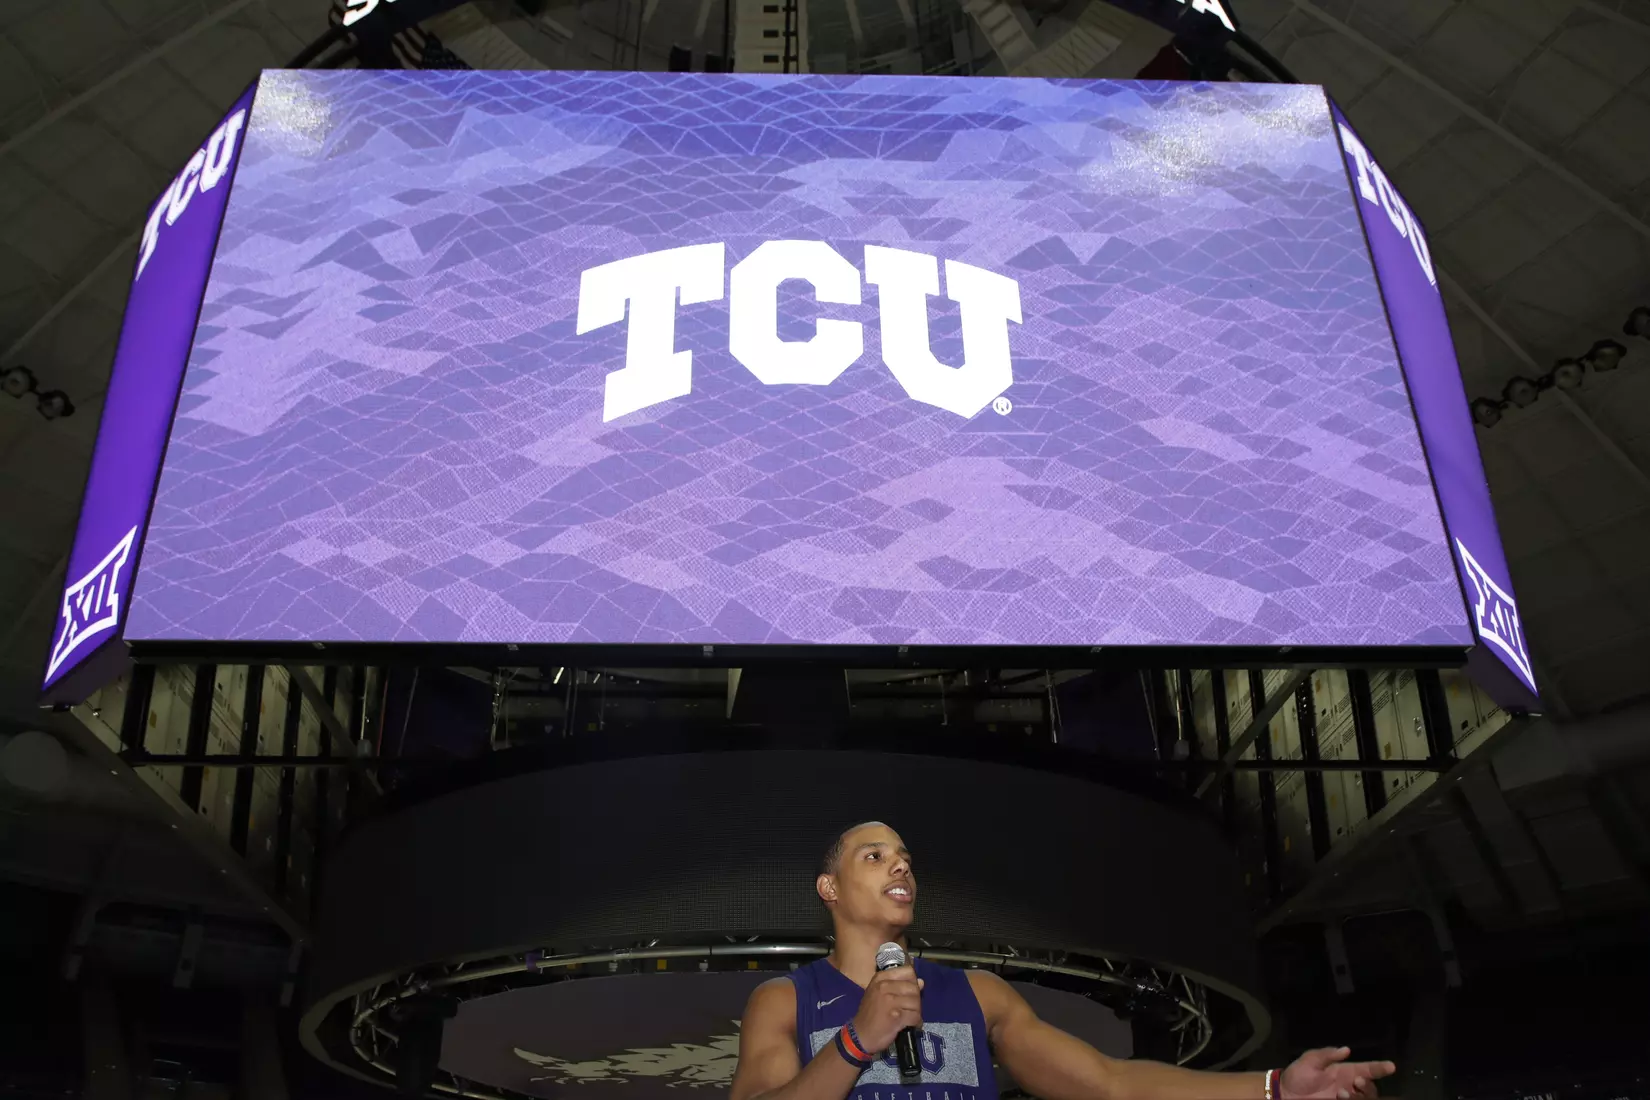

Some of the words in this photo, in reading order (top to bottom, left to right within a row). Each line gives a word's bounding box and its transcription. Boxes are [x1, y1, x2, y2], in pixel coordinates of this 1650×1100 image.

[136, 108, 246, 281] TCU
[1338, 122, 1438, 290] TCU
[576, 239, 1023, 422] TCU
